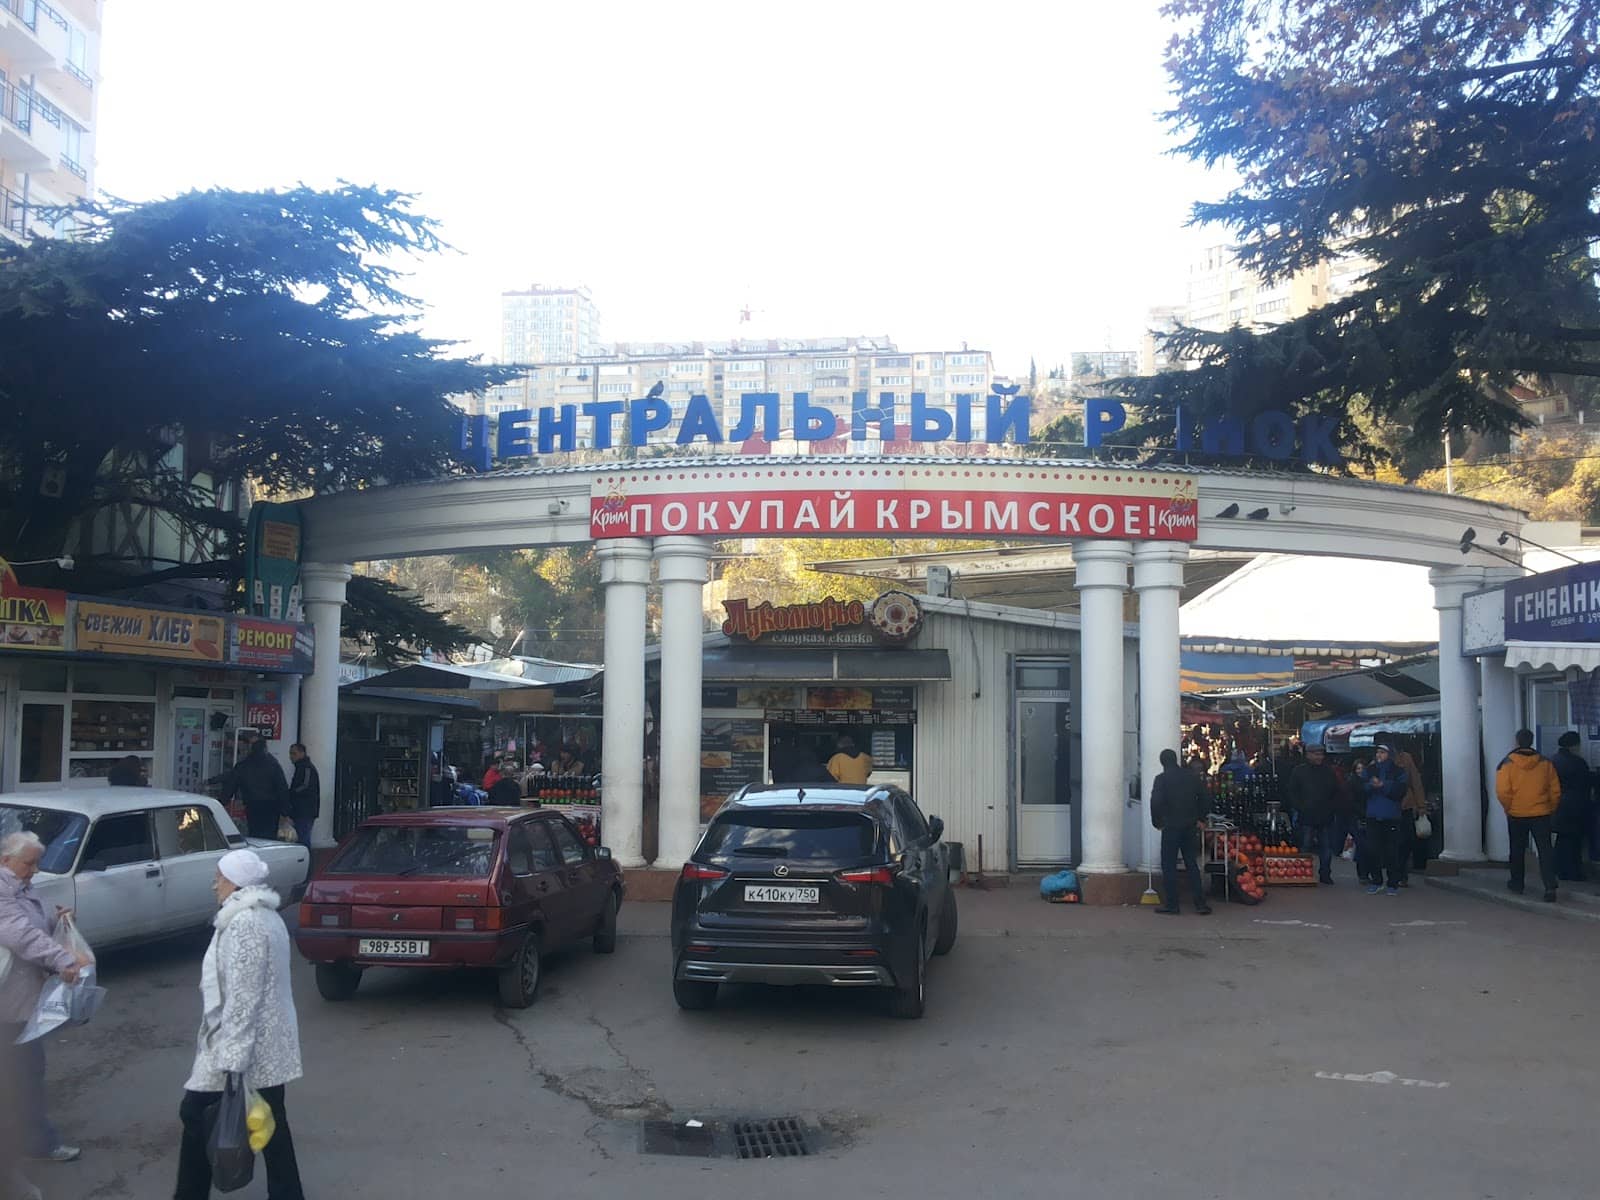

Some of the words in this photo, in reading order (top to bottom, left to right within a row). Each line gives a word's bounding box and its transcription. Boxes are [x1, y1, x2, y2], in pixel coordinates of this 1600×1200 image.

[455, 383, 1030, 471] ЦЕНТРАЛЬНЫЙ
[592, 508, 629, 535] Крым
[630, 491, 856, 533] ПОКУПАЙ
[876, 499, 1157, 536] КРЫМСКОЕ!
[1158, 509, 1196, 540] Крым
[722, 596, 865, 640] Лукоморье
[1514, 580, 1600, 624] ГЕНБАНК
[85, 613, 144, 637] СВЕЖИЙ
[148, 615, 194, 646] ХЛЕБ
[237, 628, 293, 650] РЕМОНТ
[248, 706, 280, 729] life:)
[797, 888, 816, 899] 750
